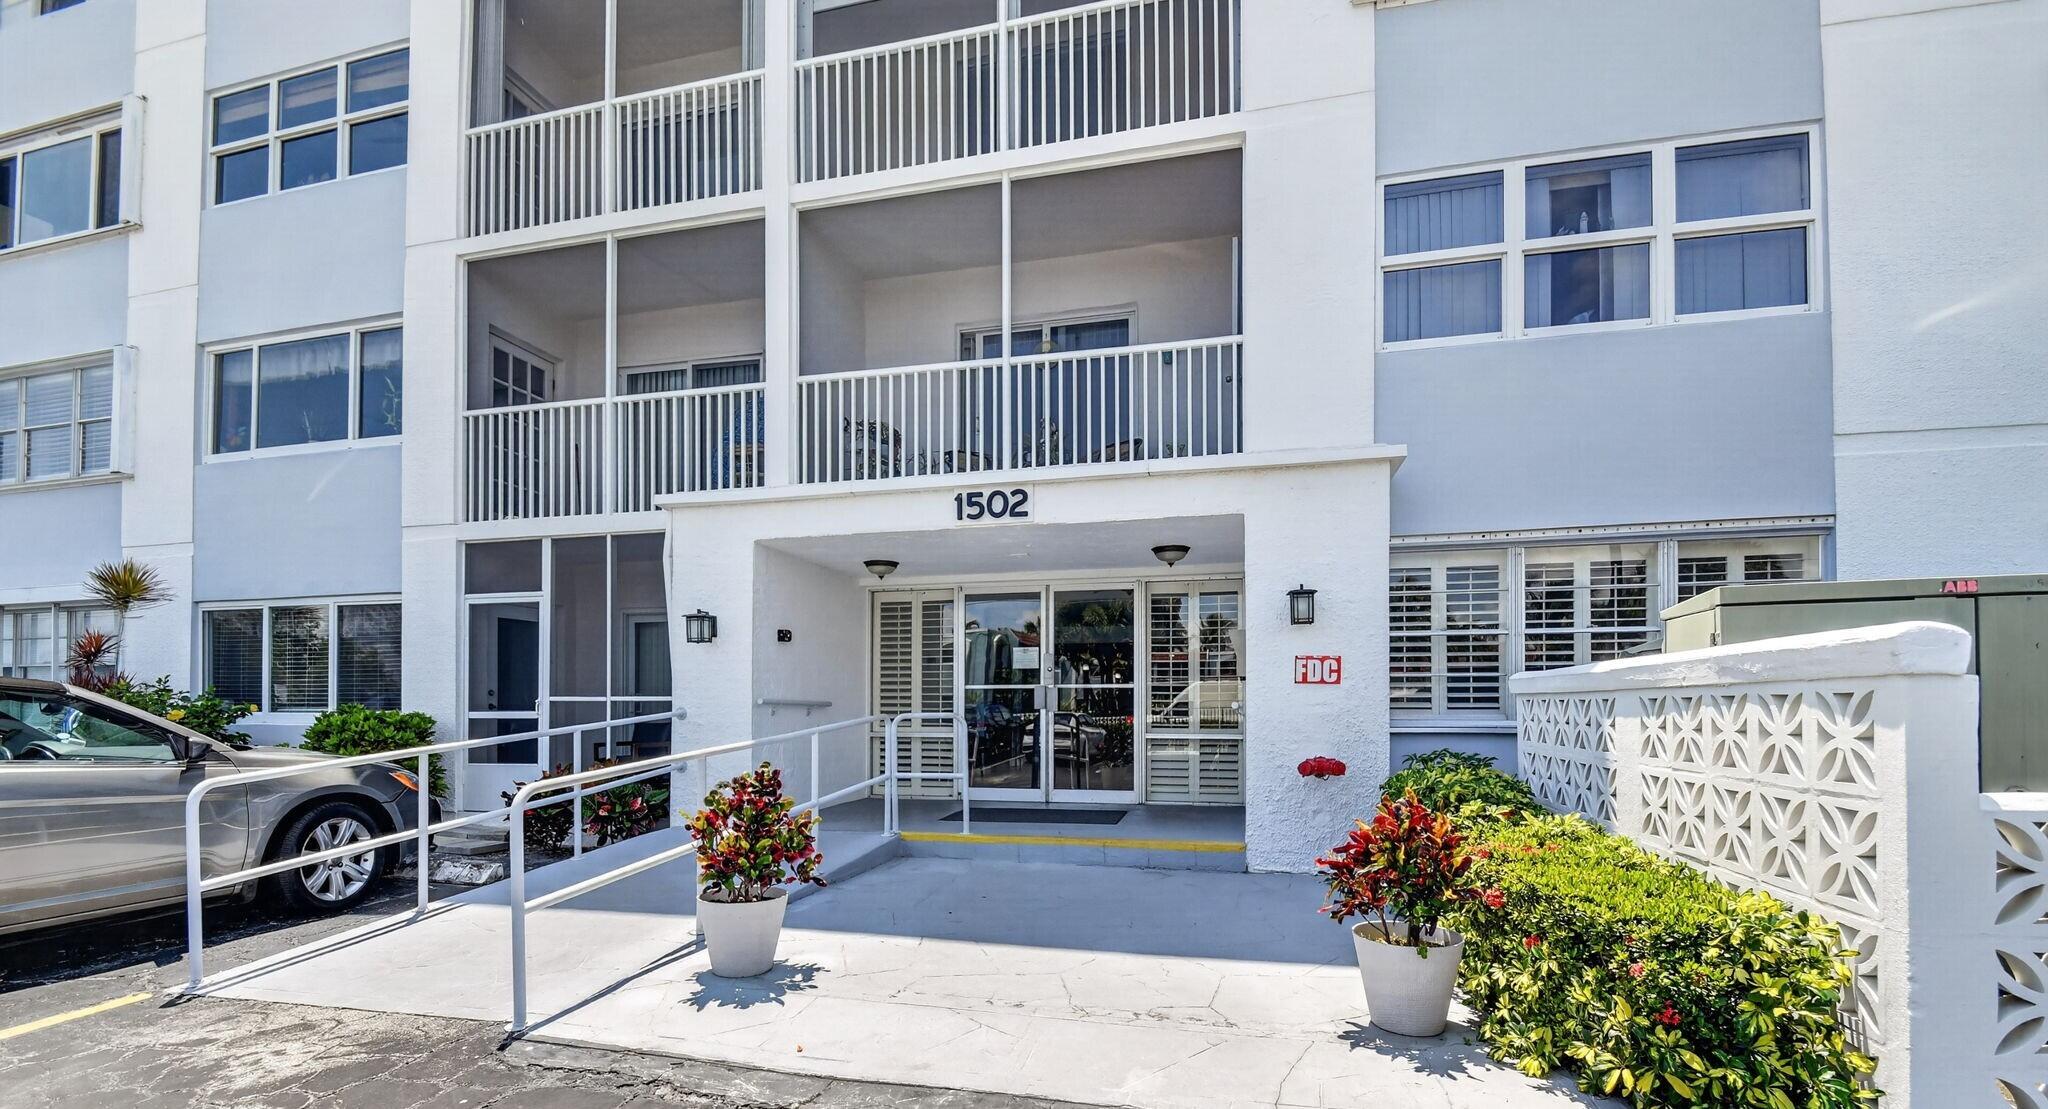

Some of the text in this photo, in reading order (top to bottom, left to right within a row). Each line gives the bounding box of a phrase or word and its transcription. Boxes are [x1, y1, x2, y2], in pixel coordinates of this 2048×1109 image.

[954, 488, 1029, 520] 1502
[1943, 580, 1978, 593] ABB
[1295, 657, 1338, 683] FDC
